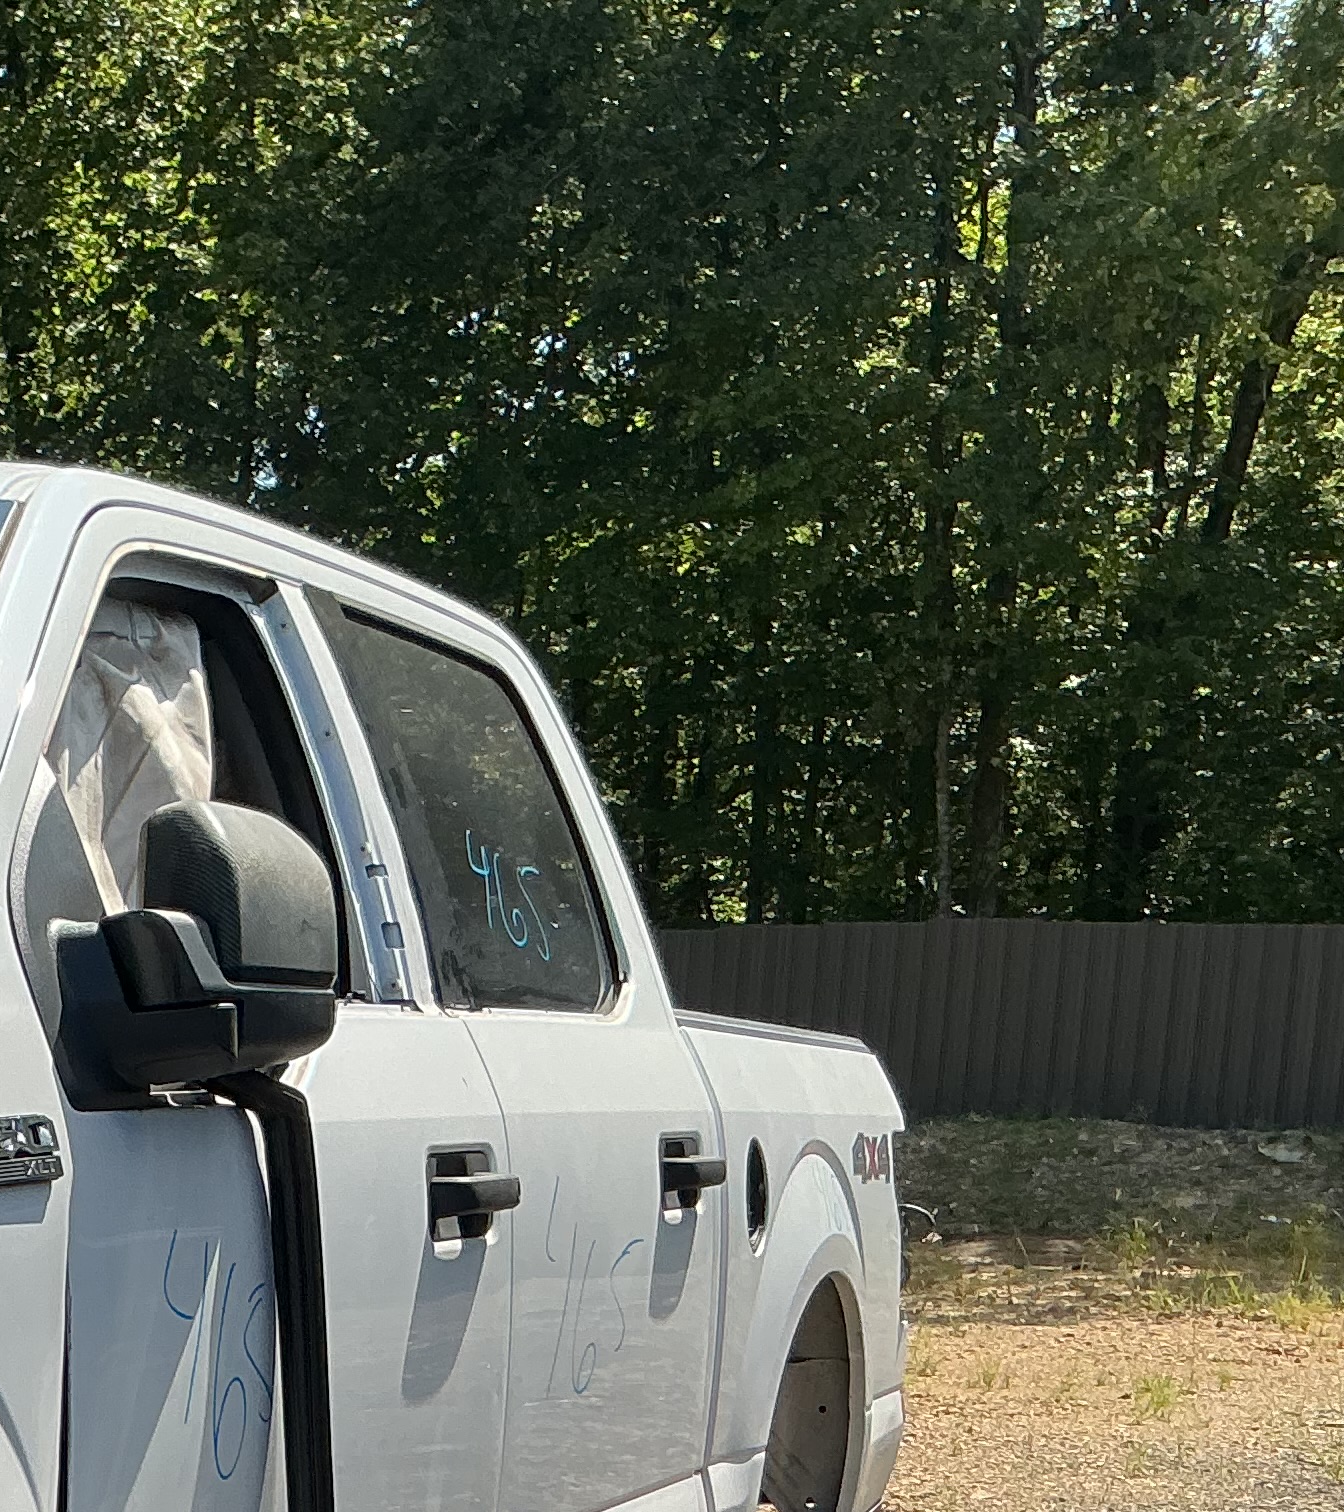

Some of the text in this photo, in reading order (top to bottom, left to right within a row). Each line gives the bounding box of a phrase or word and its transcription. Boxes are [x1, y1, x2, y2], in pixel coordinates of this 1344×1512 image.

[464, 829, 551, 962] 465
[24, 1157, 58, 1177] XLT
[163, 1228, 276, 1481] 465
